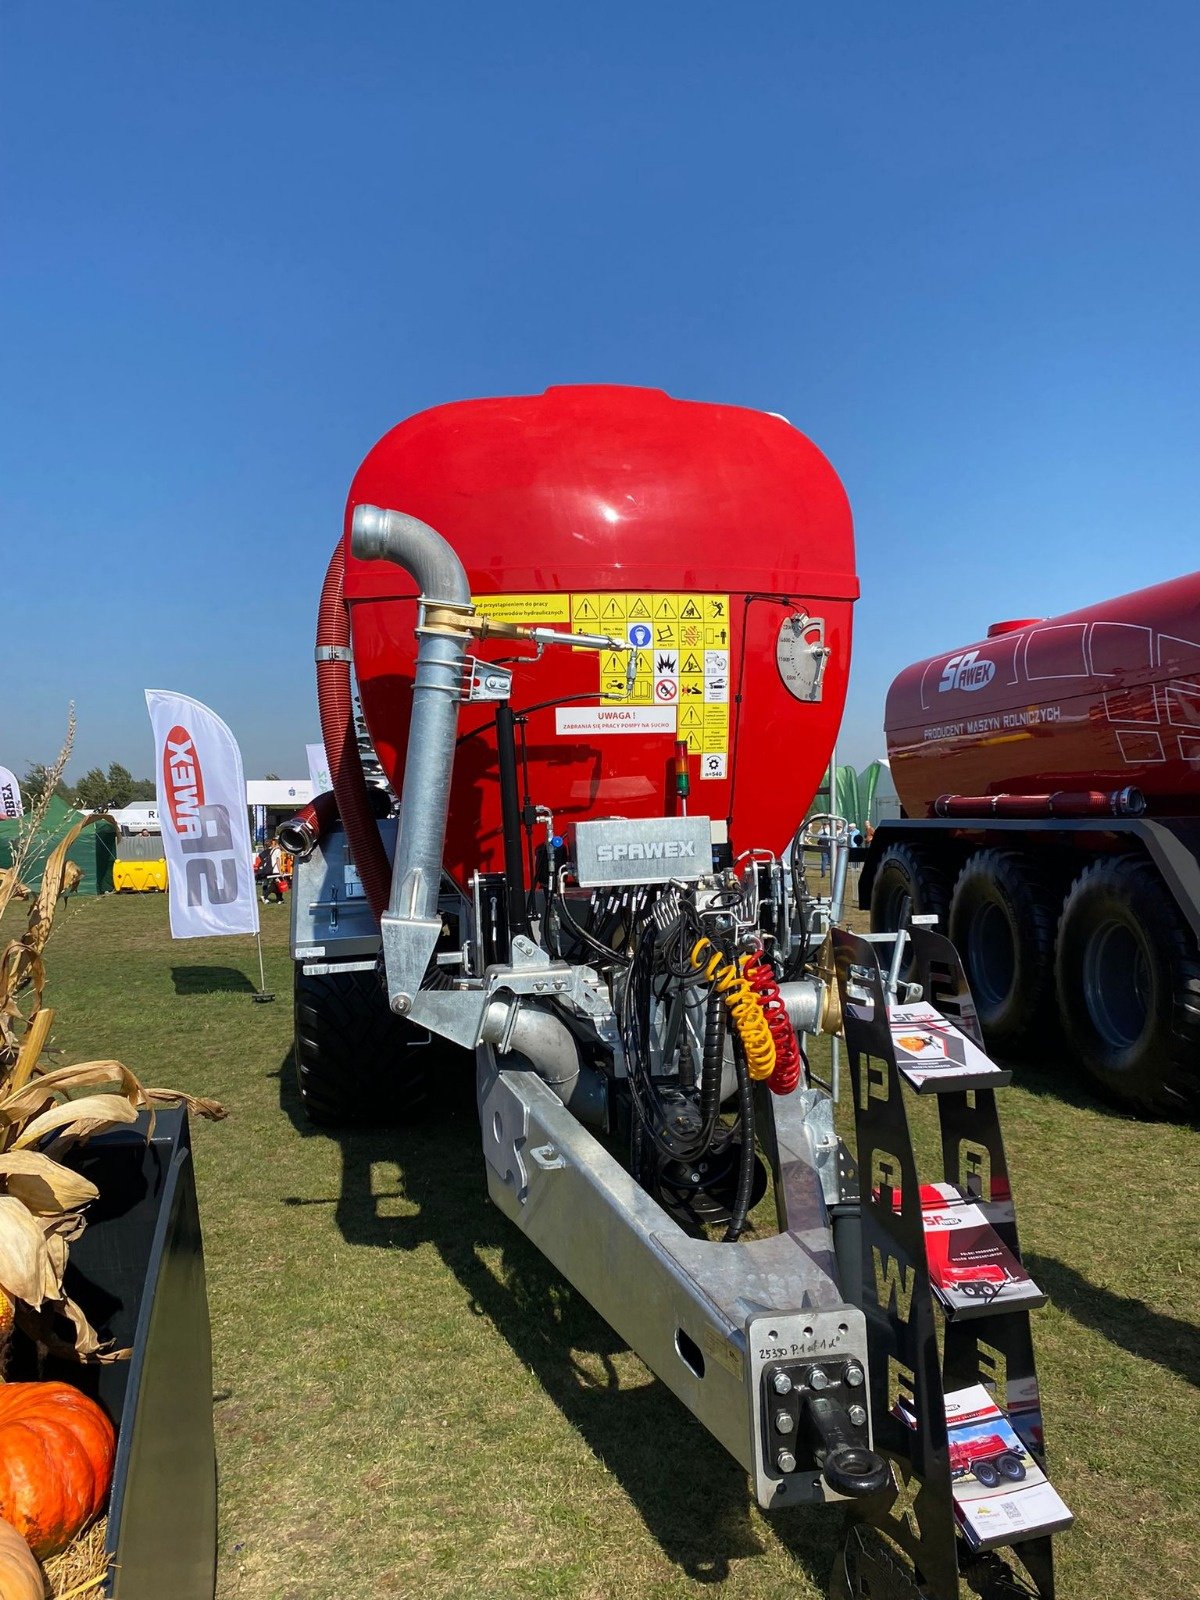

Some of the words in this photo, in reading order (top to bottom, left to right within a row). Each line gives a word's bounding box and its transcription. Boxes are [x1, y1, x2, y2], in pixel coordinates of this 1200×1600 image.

[597, 712, 631, 720] UWAGA
[924, 723, 964, 740] PRODUCENT
[967, 717, 1000, 733] MASZYN
[1003, 706, 1060, 728] ROLNICZYCH
[597, 840, 695, 862] SPAWEX
